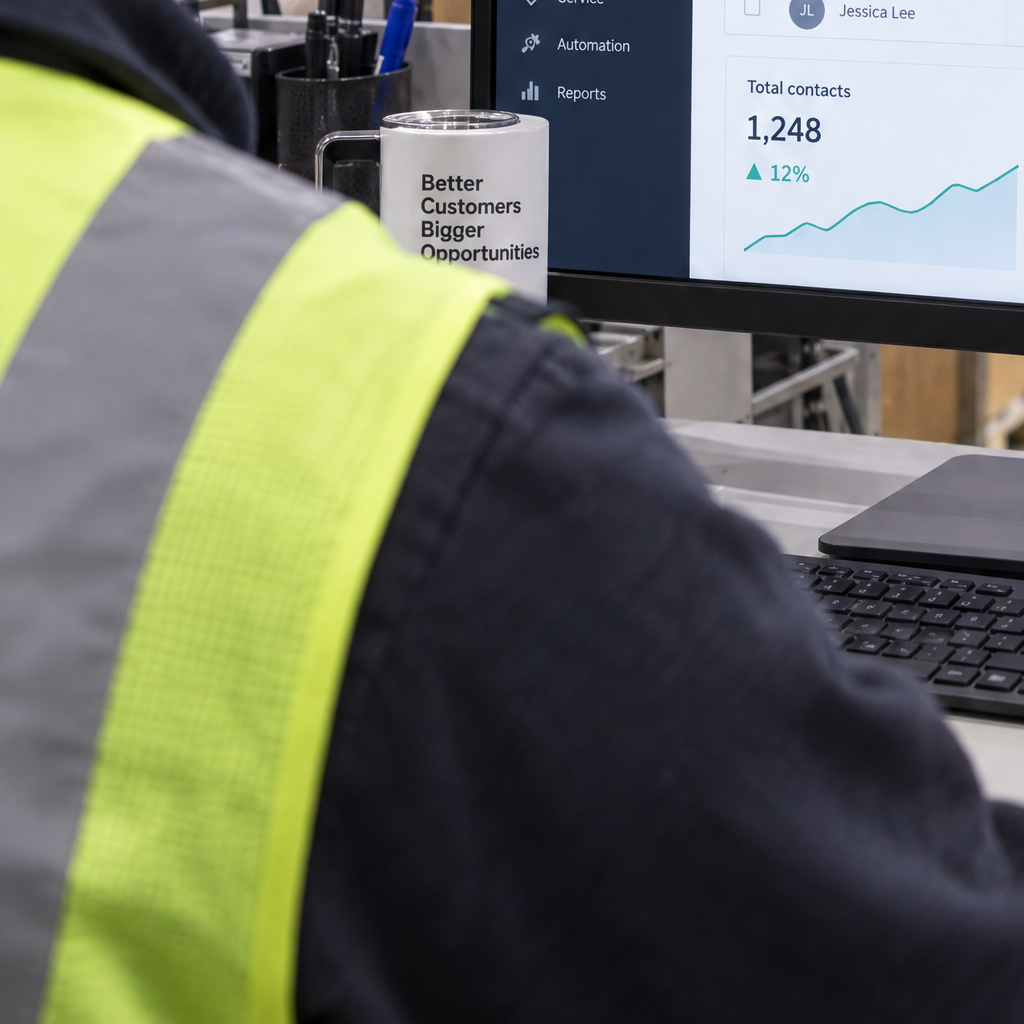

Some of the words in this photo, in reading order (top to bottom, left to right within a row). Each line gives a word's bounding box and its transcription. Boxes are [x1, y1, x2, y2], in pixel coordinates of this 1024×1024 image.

[799, 3, 815, 16] JL
[839, 3, 888, 18] Jessica
[891, 5, 916, 19] Lee
[556, 37, 630, 52] Automation
[557, 85, 607, 102] Reports
[746, 79, 783, 94] Total
[787, 83, 851, 98] contacts
[747, 114, 822, 145] 1,248
[770, 164, 810, 182] 12%
[422, 174, 483, 191] Better
[421, 197, 521, 214] Customers
[422, 221, 484, 242] Bigger
[421, 244, 539, 265] Opportunities
